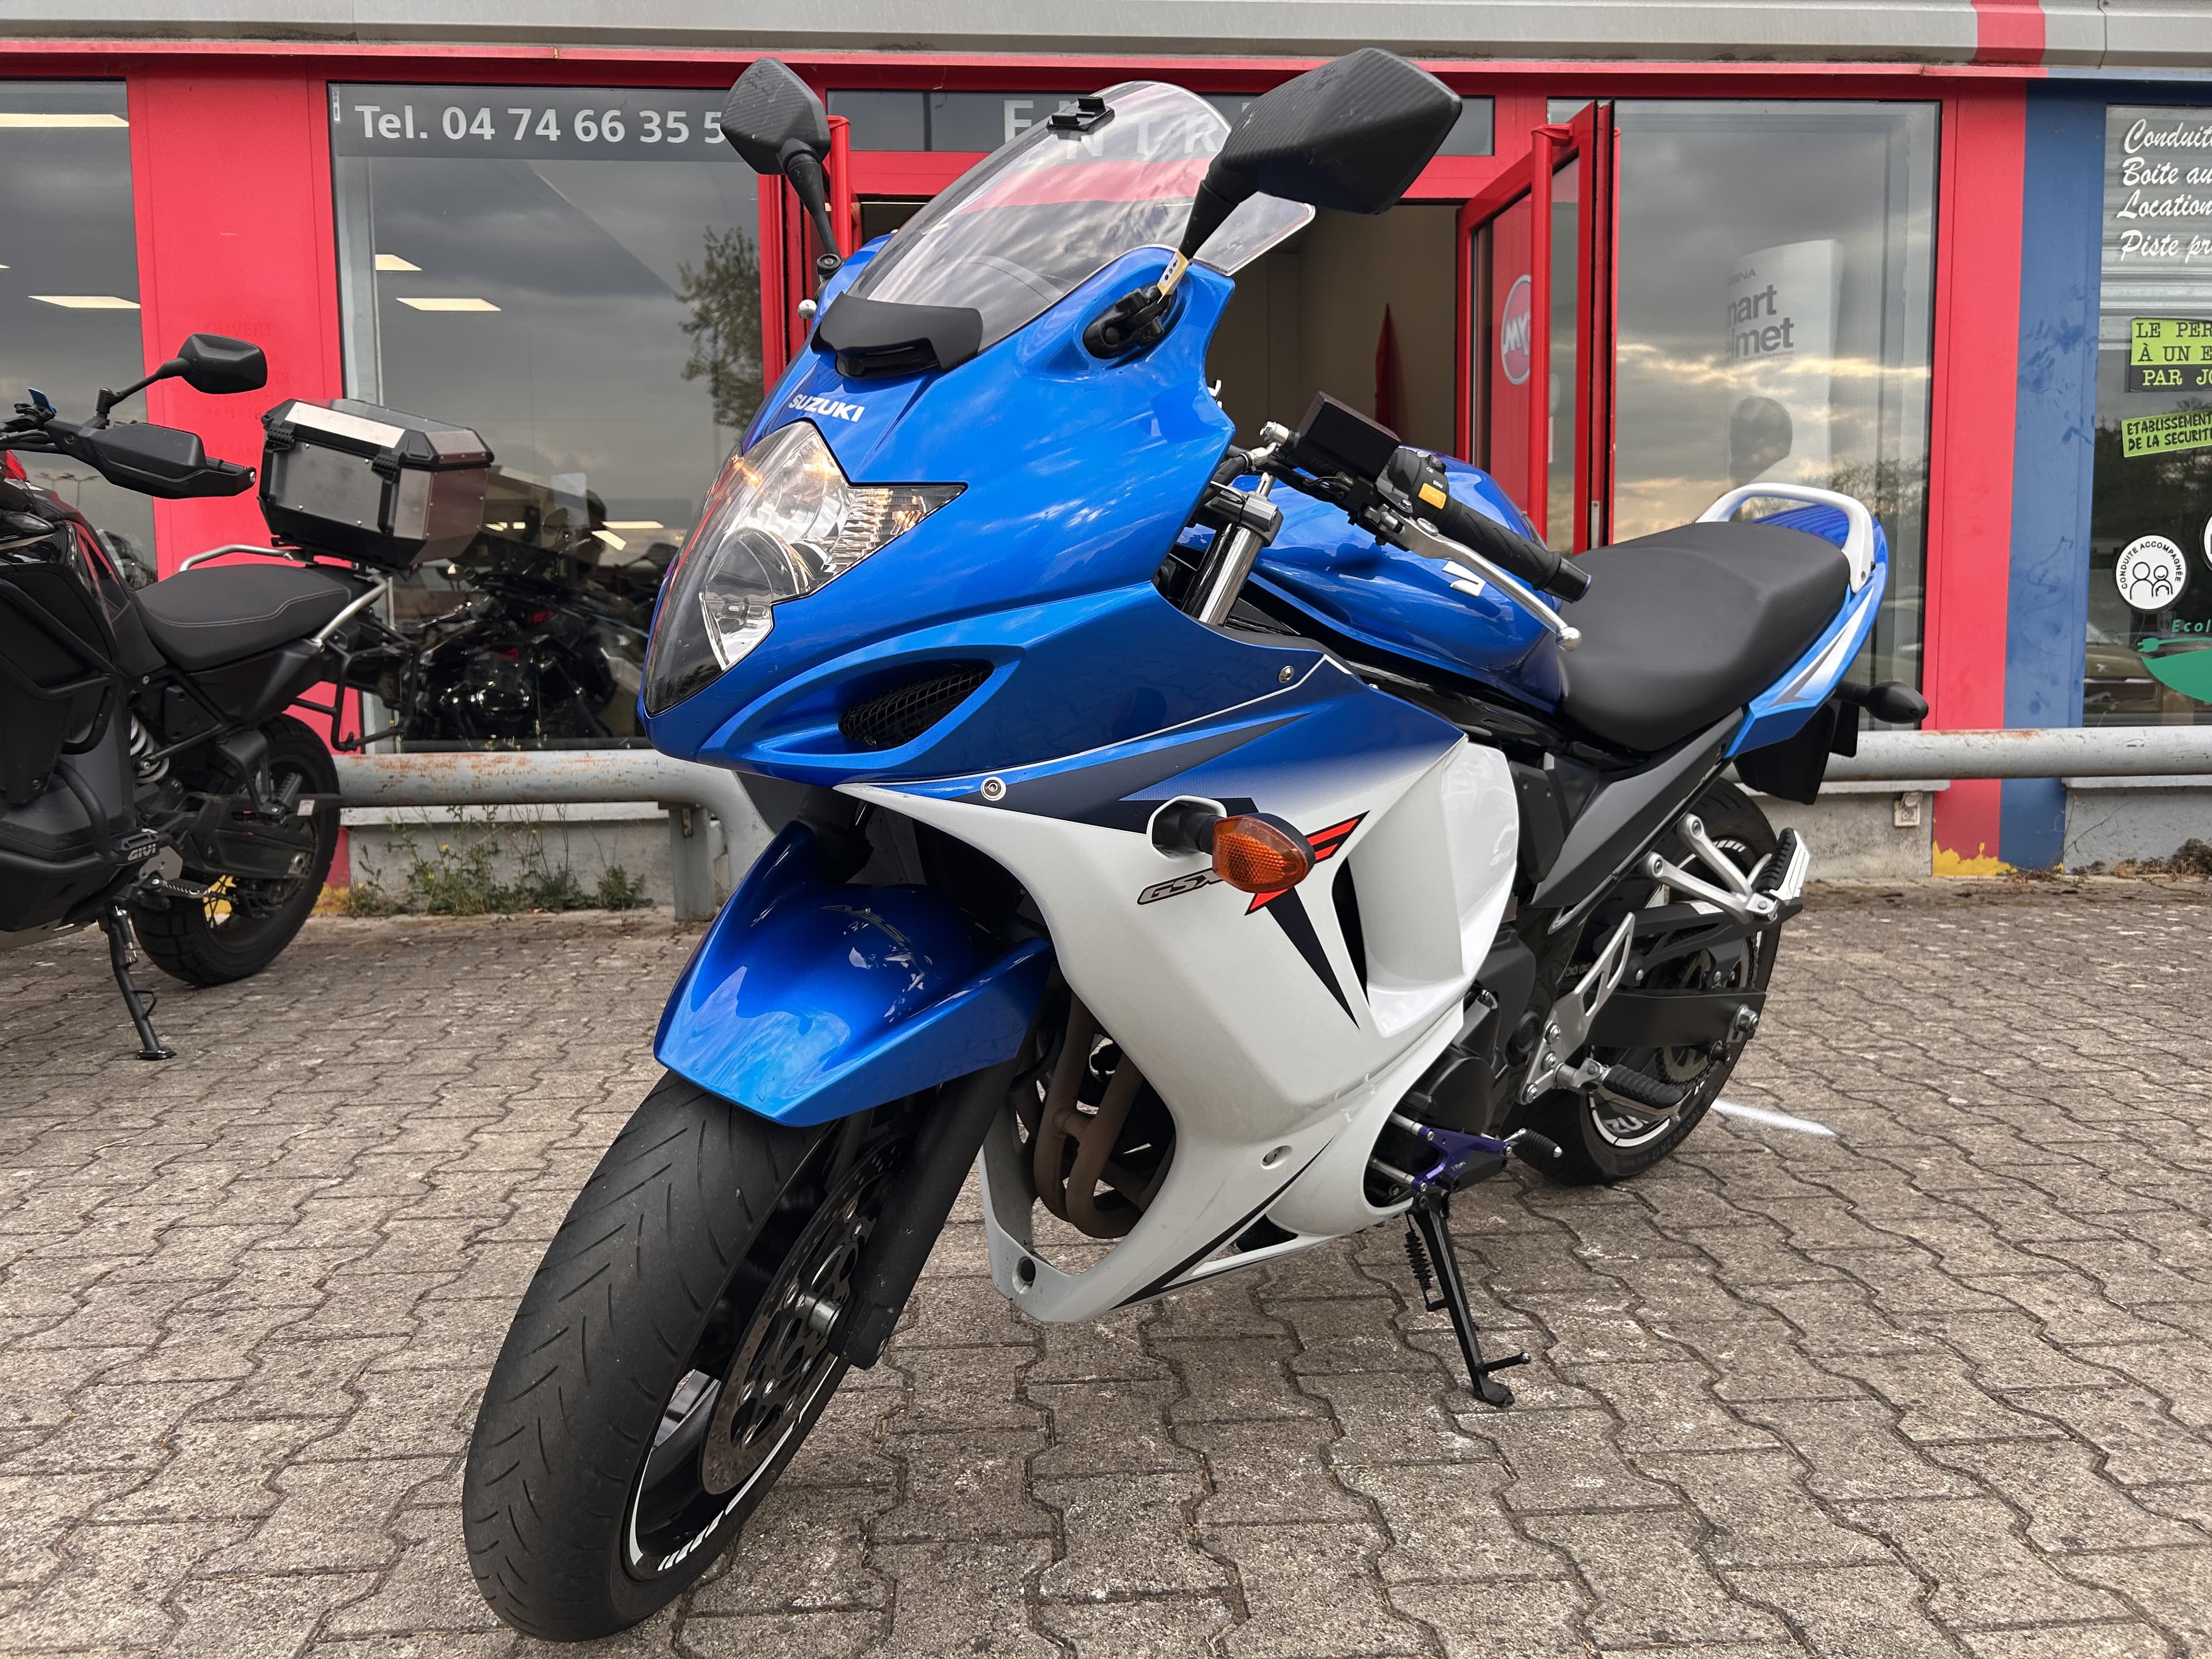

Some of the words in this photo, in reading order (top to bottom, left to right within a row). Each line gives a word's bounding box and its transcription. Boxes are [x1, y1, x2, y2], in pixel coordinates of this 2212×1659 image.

[354, 105, 427, 139] Tel.
[442, 107, 495, 140] 04
[507, 108, 561, 142] 74
[574, 109, 626, 143] 66
[639, 110, 690, 143] 35
[703, 111, 726, 144] 5
[2122, 157, 2179, 185] Boite
[2116, 189, 2212, 219] Location
[2120, 229, 2179, 262] Piste
[2185, 235, 2212, 263] pr
[2136, 323, 2160, 338] LE
[2138, 343, 2153, 362] À
[2162, 346, 2191, 361] UN
[2142, 369, 2183, 386] PAR
[788, 393, 865, 422] SUZUKI
[2128, 437, 2142, 451] DE
[2146, 434, 2160, 448] LA
[2120, 547, 2139, 589] CONDUITE
[2140, 540, 2184, 582] ACCOMPAGNÉE
[127, 843, 156, 861] GIVI
